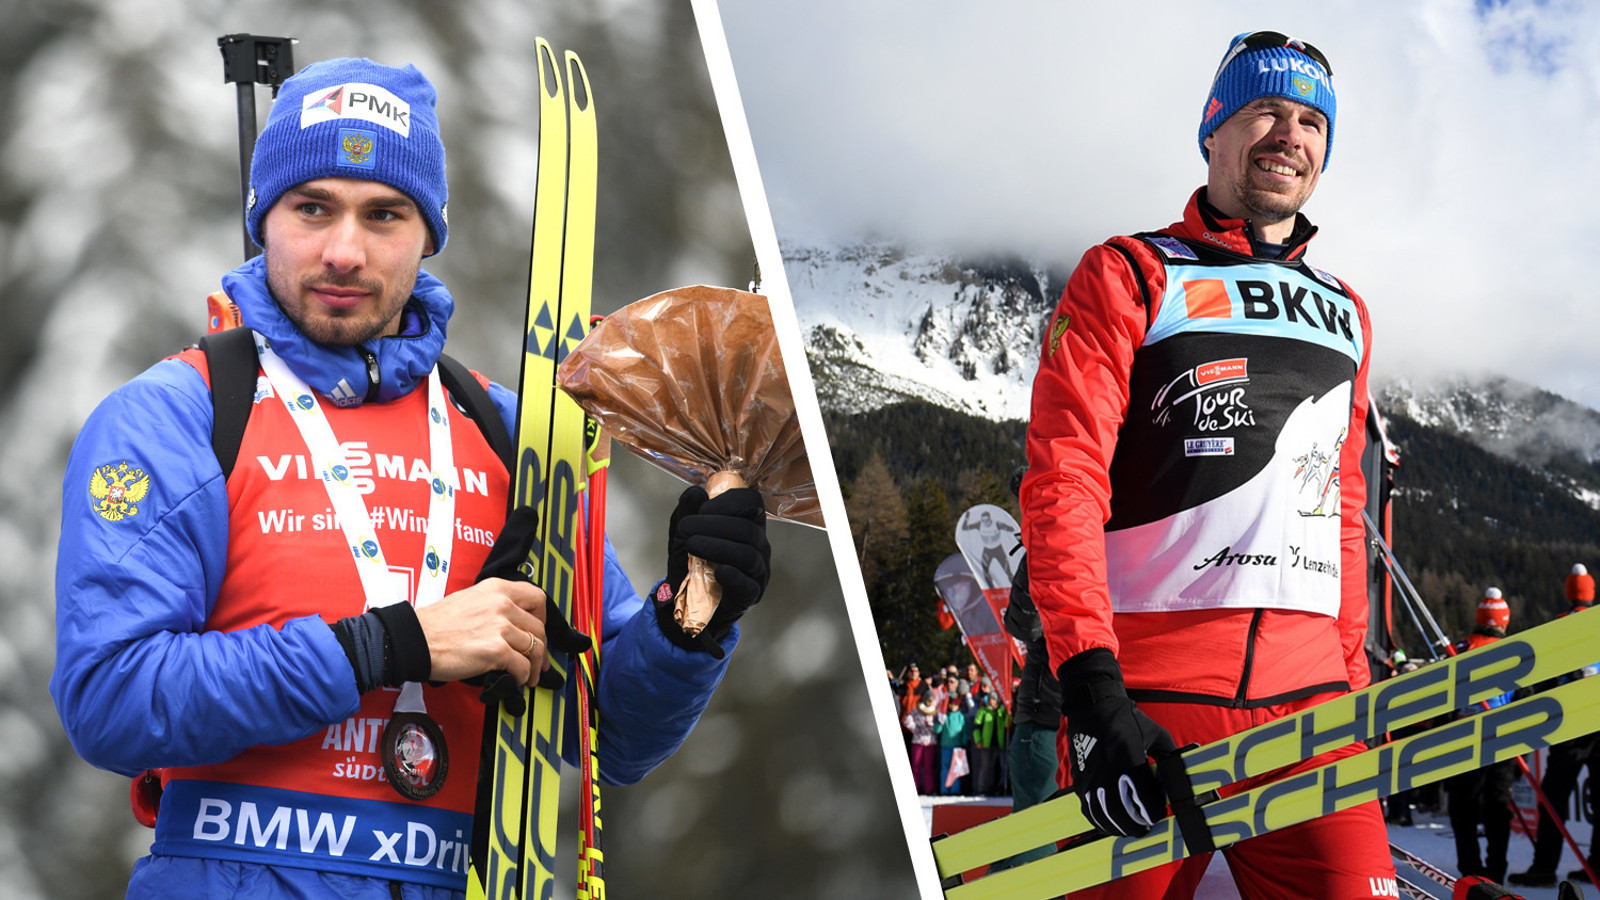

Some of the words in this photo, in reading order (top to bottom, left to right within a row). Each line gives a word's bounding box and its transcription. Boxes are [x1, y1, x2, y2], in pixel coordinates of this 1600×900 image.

[349, 92, 407, 127] PMK
[1235, 279, 1355, 343] BKW
[1200, 366, 1244, 376] VIESSMANN
[1198, 415, 1218, 432] de
[258, 509, 305, 534] Wir
[1193, 546, 1278, 571] Arosa
[193, 798, 358, 857] BMW
